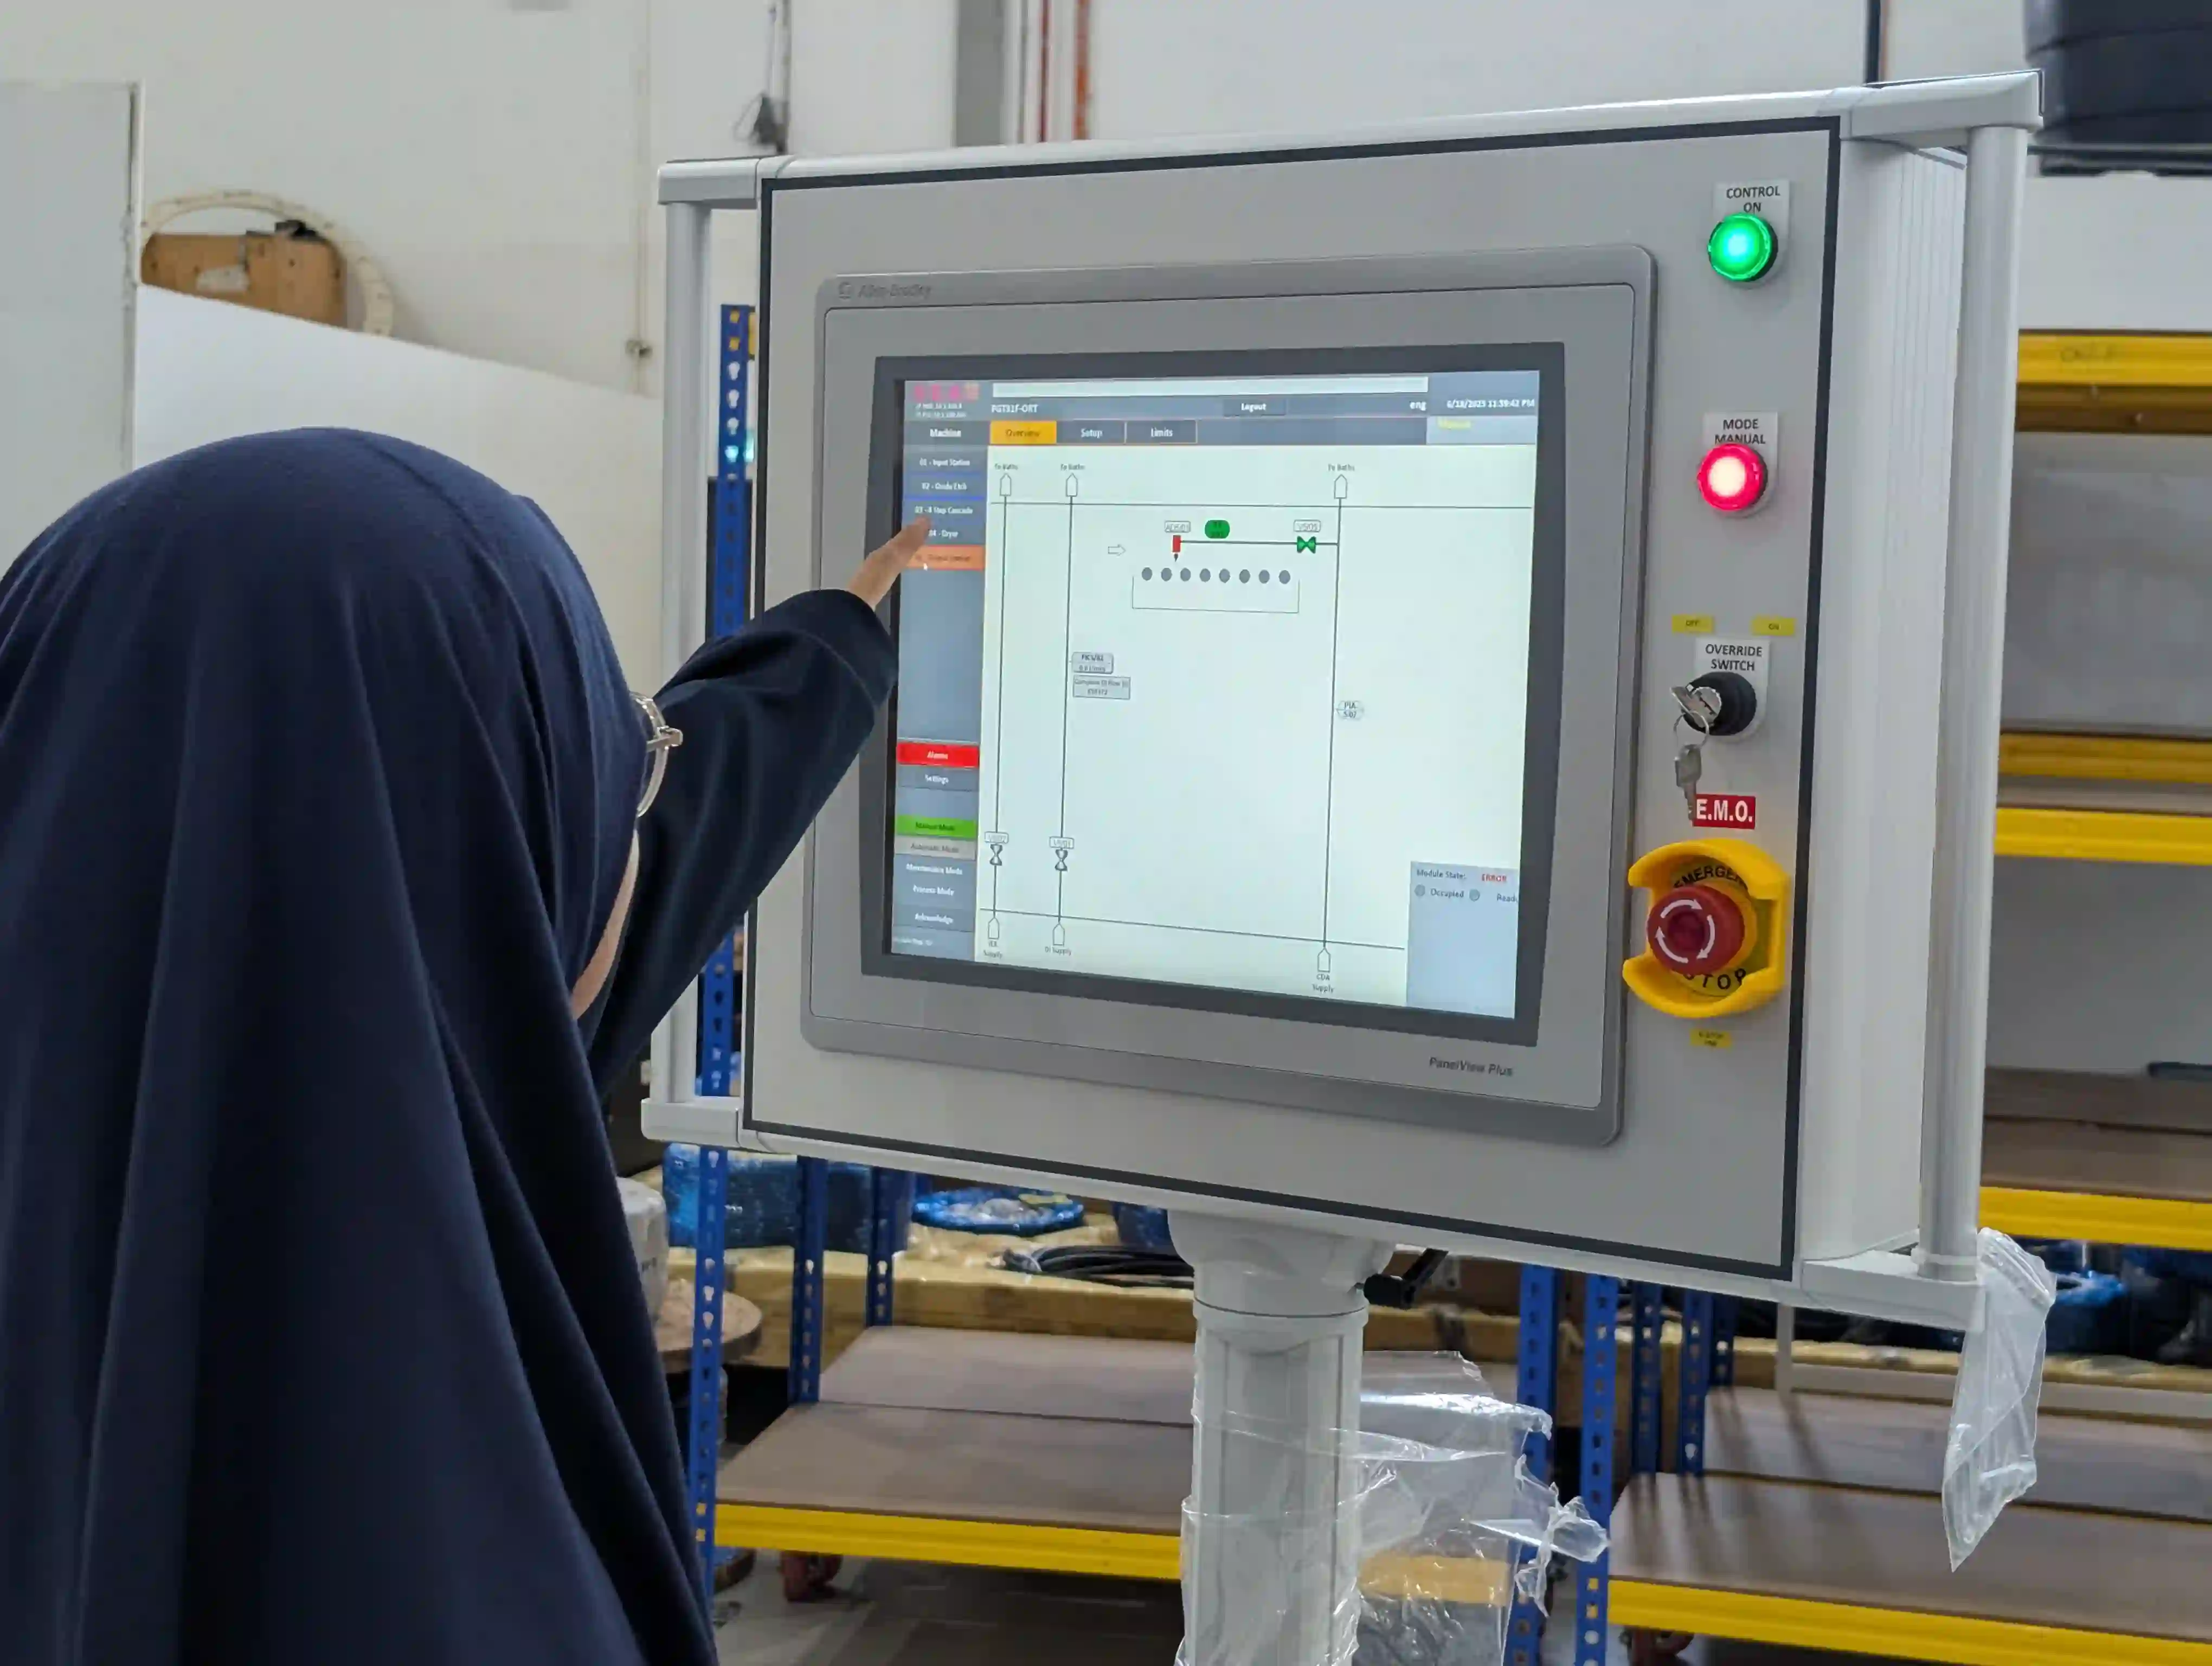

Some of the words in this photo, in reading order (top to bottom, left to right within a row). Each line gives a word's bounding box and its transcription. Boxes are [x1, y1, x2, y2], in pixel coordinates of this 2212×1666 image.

[1726, 185, 1780, 198] CONTROL
[1743, 202, 1761, 213] ON
[1241, 402, 1266, 413] Logout
[1410, 401, 1427, 411] eng
[1522, 398, 1535, 407] PM
[1723, 419, 1759, 430] MODE
[1005, 429, 1041, 438] Overview
[1081, 427, 1103, 438] Setup
[1150, 427, 1173, 437] Limits
[1715, 434, 1766, 445] MANUAL
[1705, 643, 1763, 657] OVERRIDE
[1711, 658, 1756, 671] SWITCH
[1696, 799, 1753, 823] E.M.O.
[1417, 869, 1443, 878] Module
[1481, 873, 1507, 882] ERROR
[1430, 888, 1464, 899] Occupied
[1312, 984, 1335, 994] Supply
[1429, 1056, 1485, 1073] PanelView
[1488, 1063, 1513, 1077] Plus
